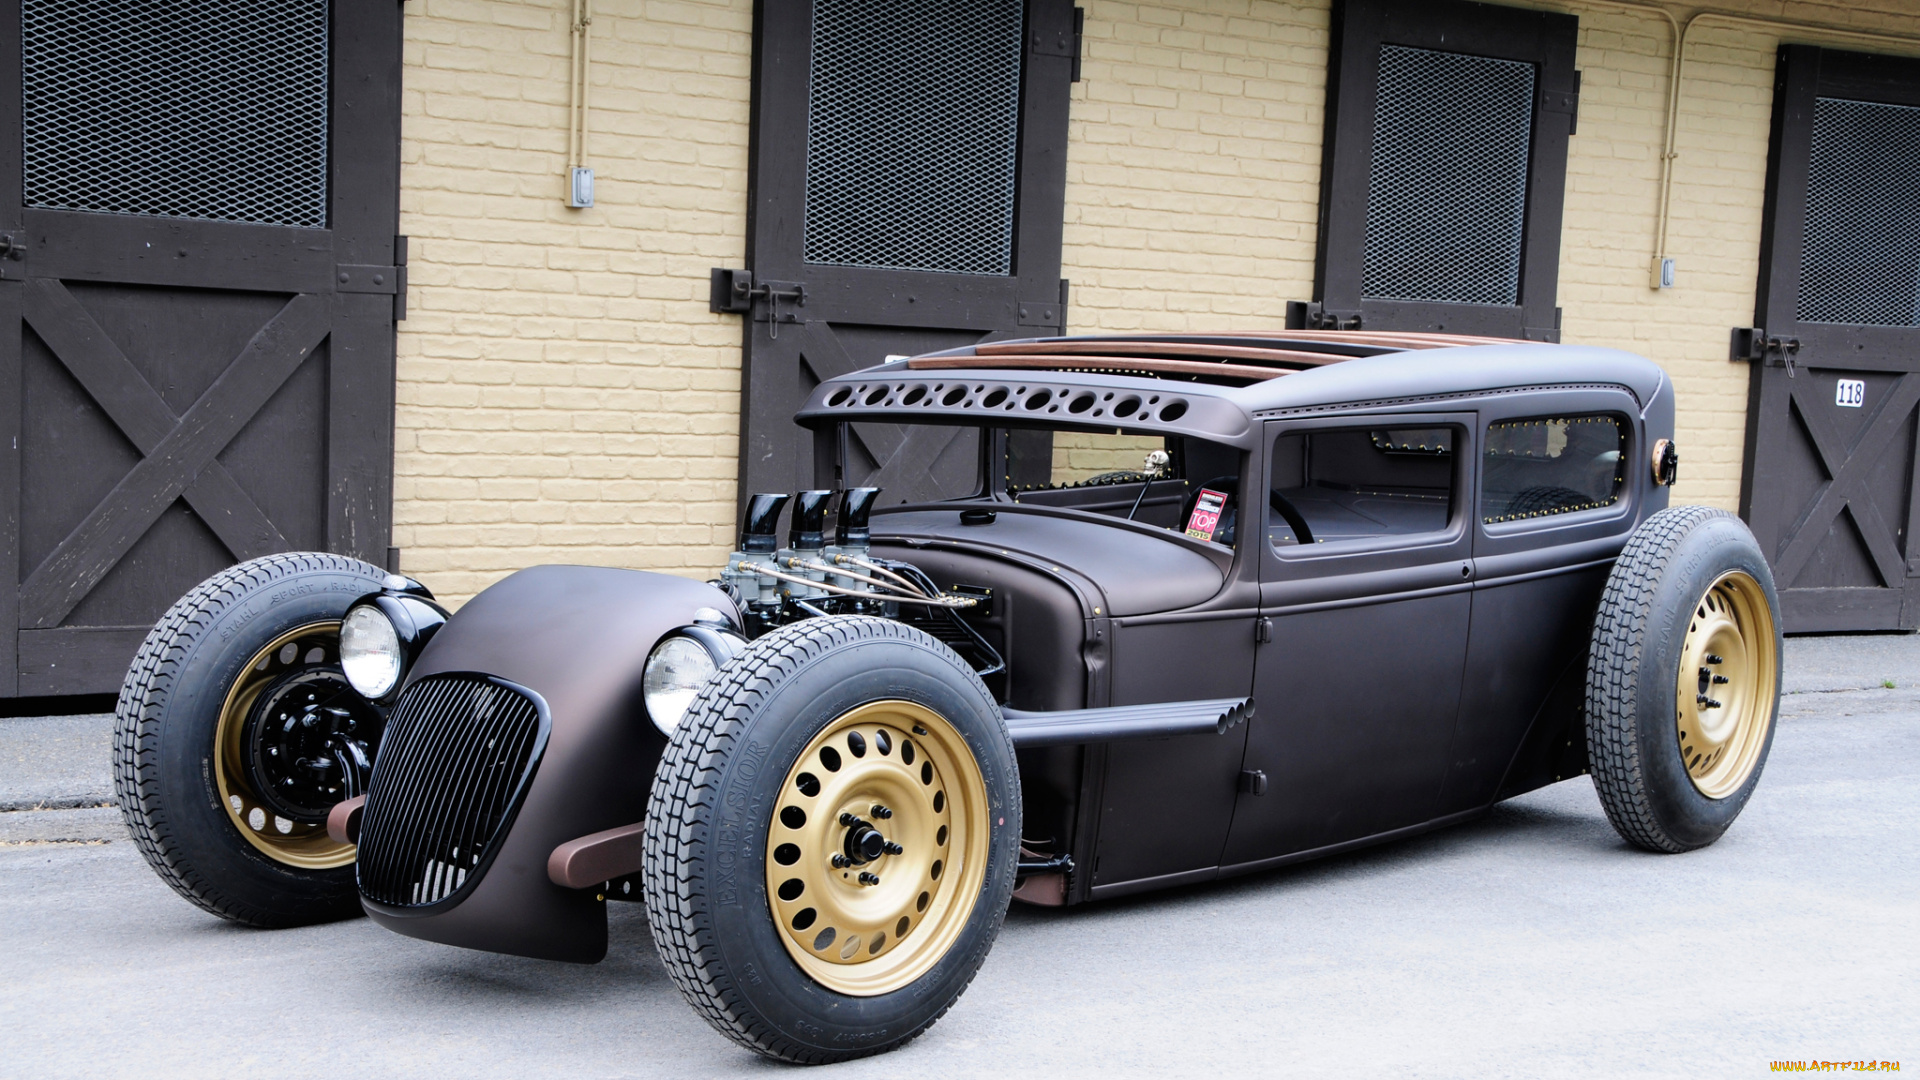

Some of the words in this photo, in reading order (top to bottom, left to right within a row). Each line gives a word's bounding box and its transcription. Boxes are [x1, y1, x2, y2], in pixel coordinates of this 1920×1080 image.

[1838, 382, 1862, 404] 118
[1192, 512, 1217, 529] TOP
[1187, 529, 1209, 540] 2015
[271, 583, 314, 605] SPORT
[715, 740, 769, 908] EXCELSIOR
[742, 793, 764, 859] RADIAL
